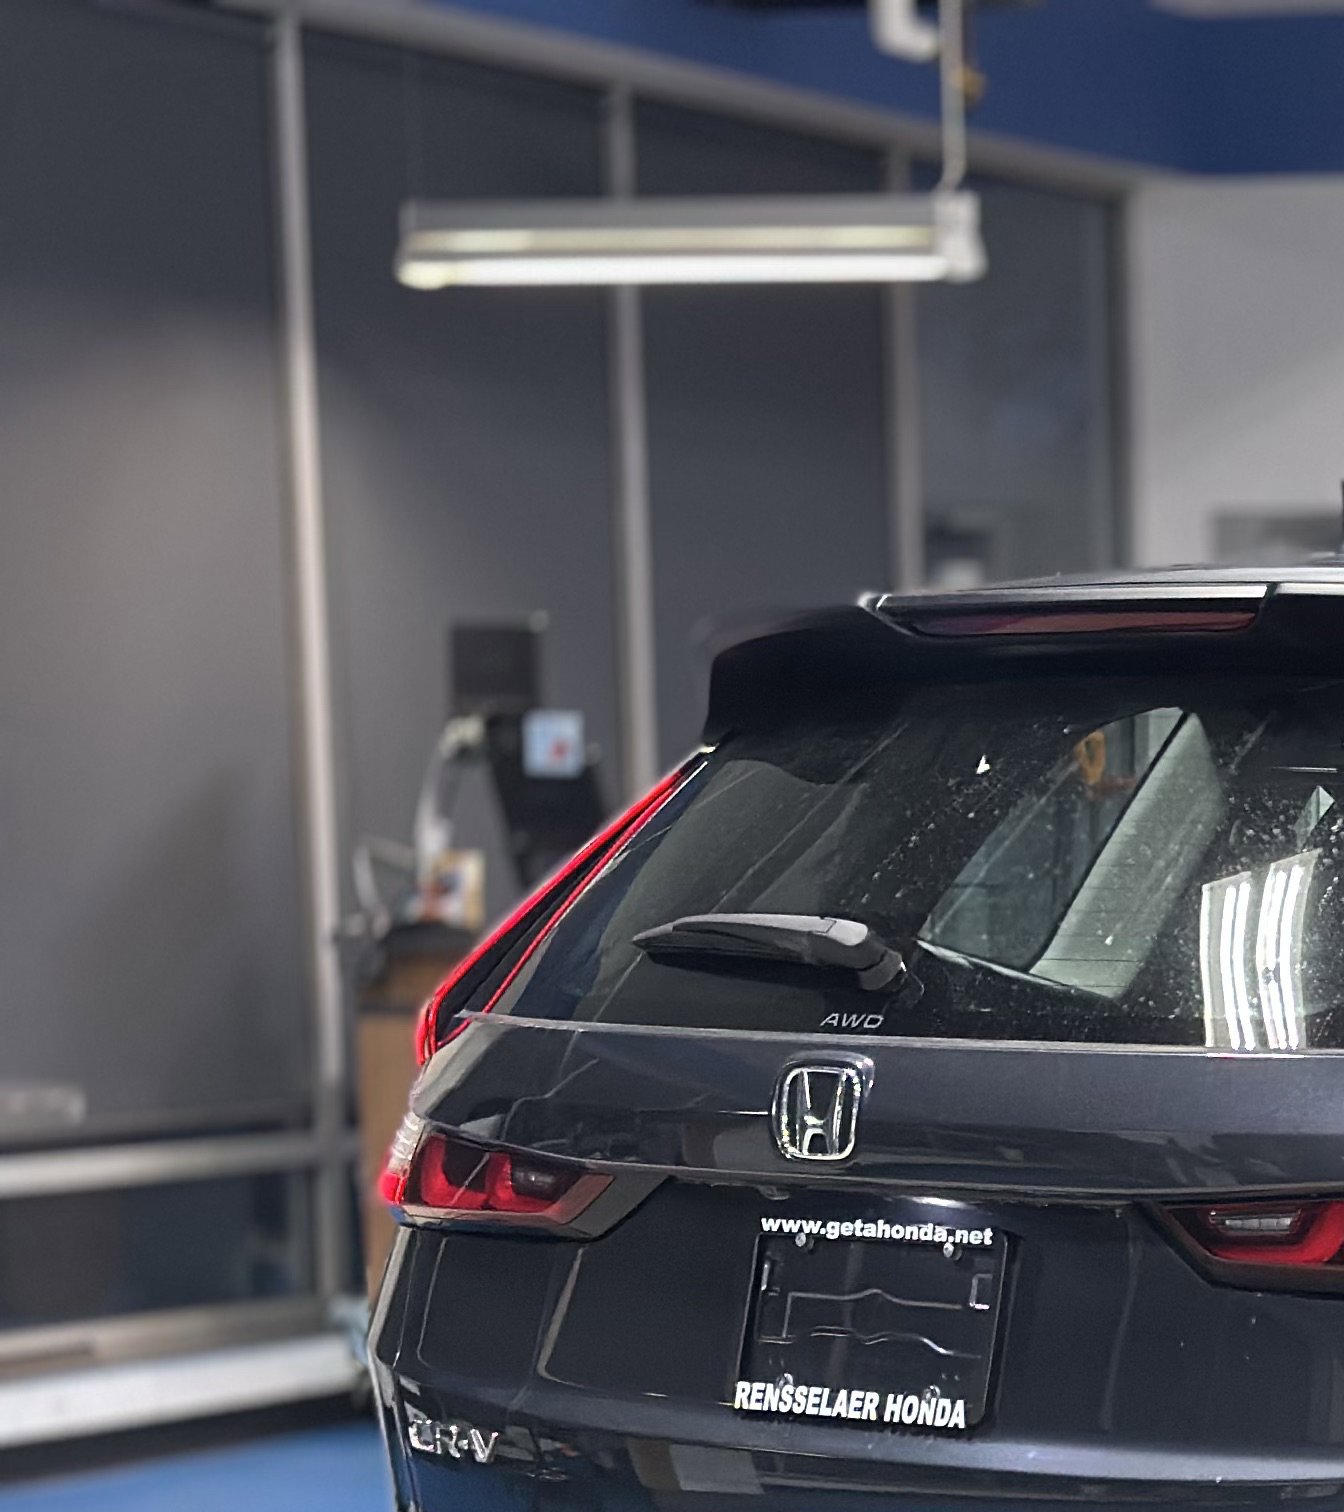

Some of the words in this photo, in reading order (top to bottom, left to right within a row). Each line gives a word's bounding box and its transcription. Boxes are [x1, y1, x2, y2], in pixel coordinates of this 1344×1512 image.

[820, 1012, 885, 1028] AWD
[760, 1217, 994, 1246] www.getahonda.net
[734, 1380, 880, 1421] RENSSELAER
[884, 1393, 966, 1429] HONDA
